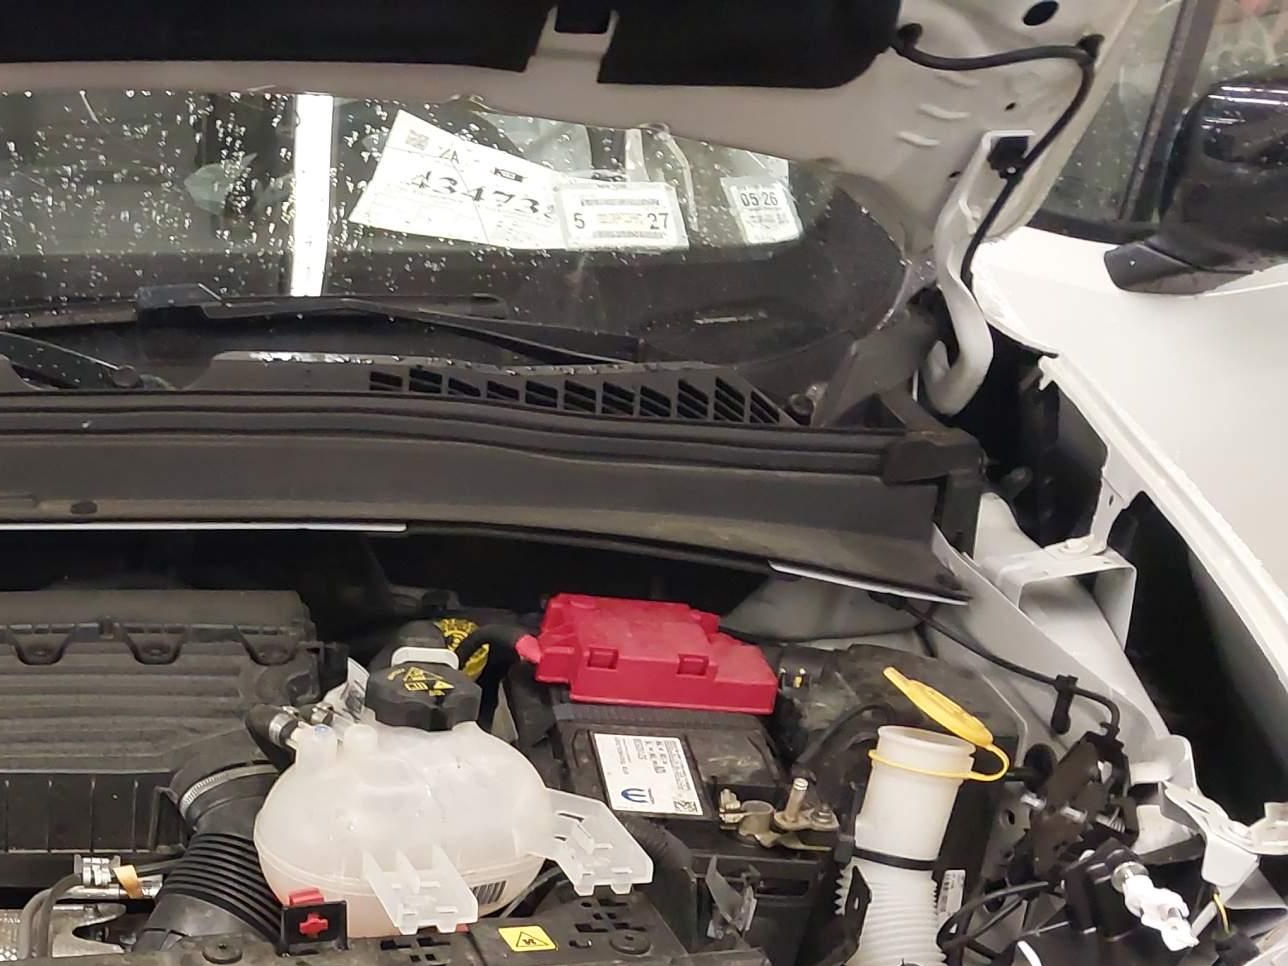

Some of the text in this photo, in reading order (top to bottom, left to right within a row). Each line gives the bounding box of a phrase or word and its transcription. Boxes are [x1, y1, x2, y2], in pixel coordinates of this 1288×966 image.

[740, 191, 778, 207] 05 26
[573, 212, 586, 229] 5
[647, 212, 670, 230] 27
